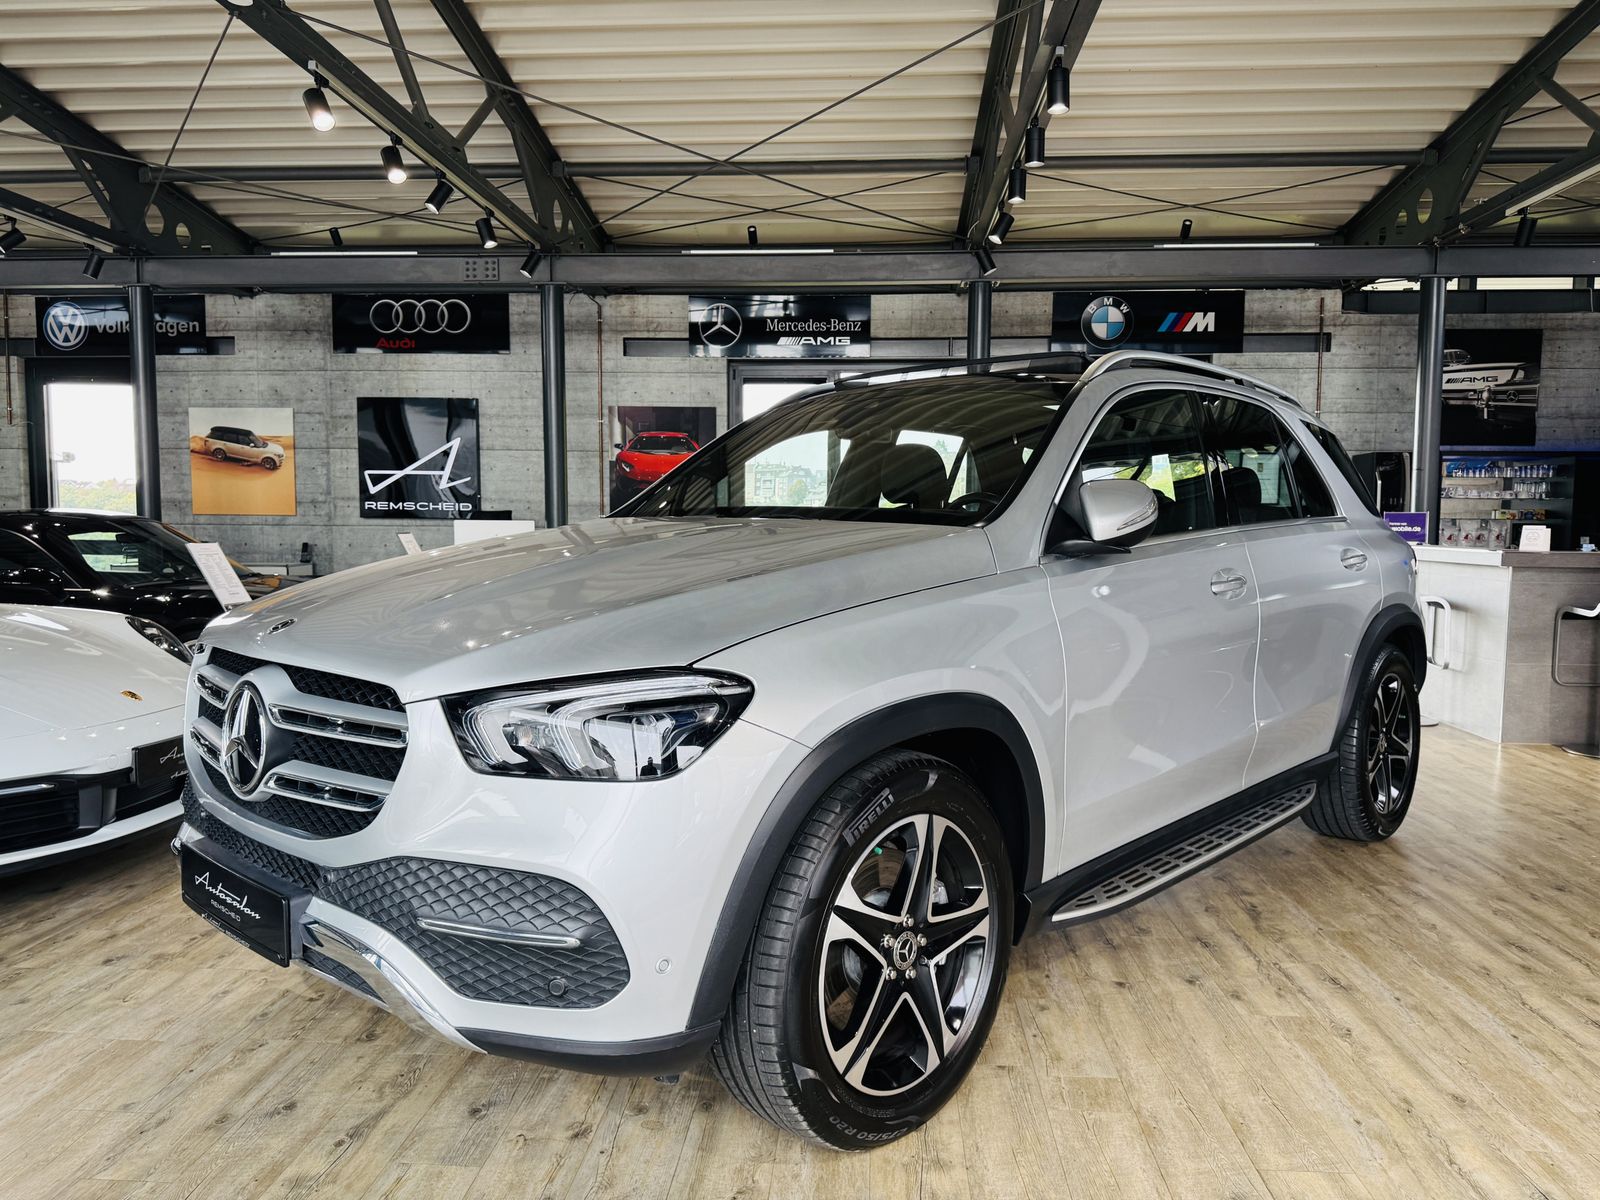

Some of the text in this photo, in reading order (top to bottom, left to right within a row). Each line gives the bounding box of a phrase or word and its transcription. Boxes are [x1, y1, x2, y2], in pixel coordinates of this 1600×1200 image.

[1087, 297, 1130, 314] BMW
[96, 319, 200, 337] Volkagen
[766, 318, 862, 332] Mercedes-Benz
[376, 337, 416, 349] Audi
[798, 336, 851, 346] AMG
[1460, 375, 1499, 384] AMG
[364, 501, 473, 511] REMSCHEID
[842, 787, 895, 848] PIRELLI
[194, 872, 261, 919] Autosalon
[210, 899, 241, 922] REMSCHEID
